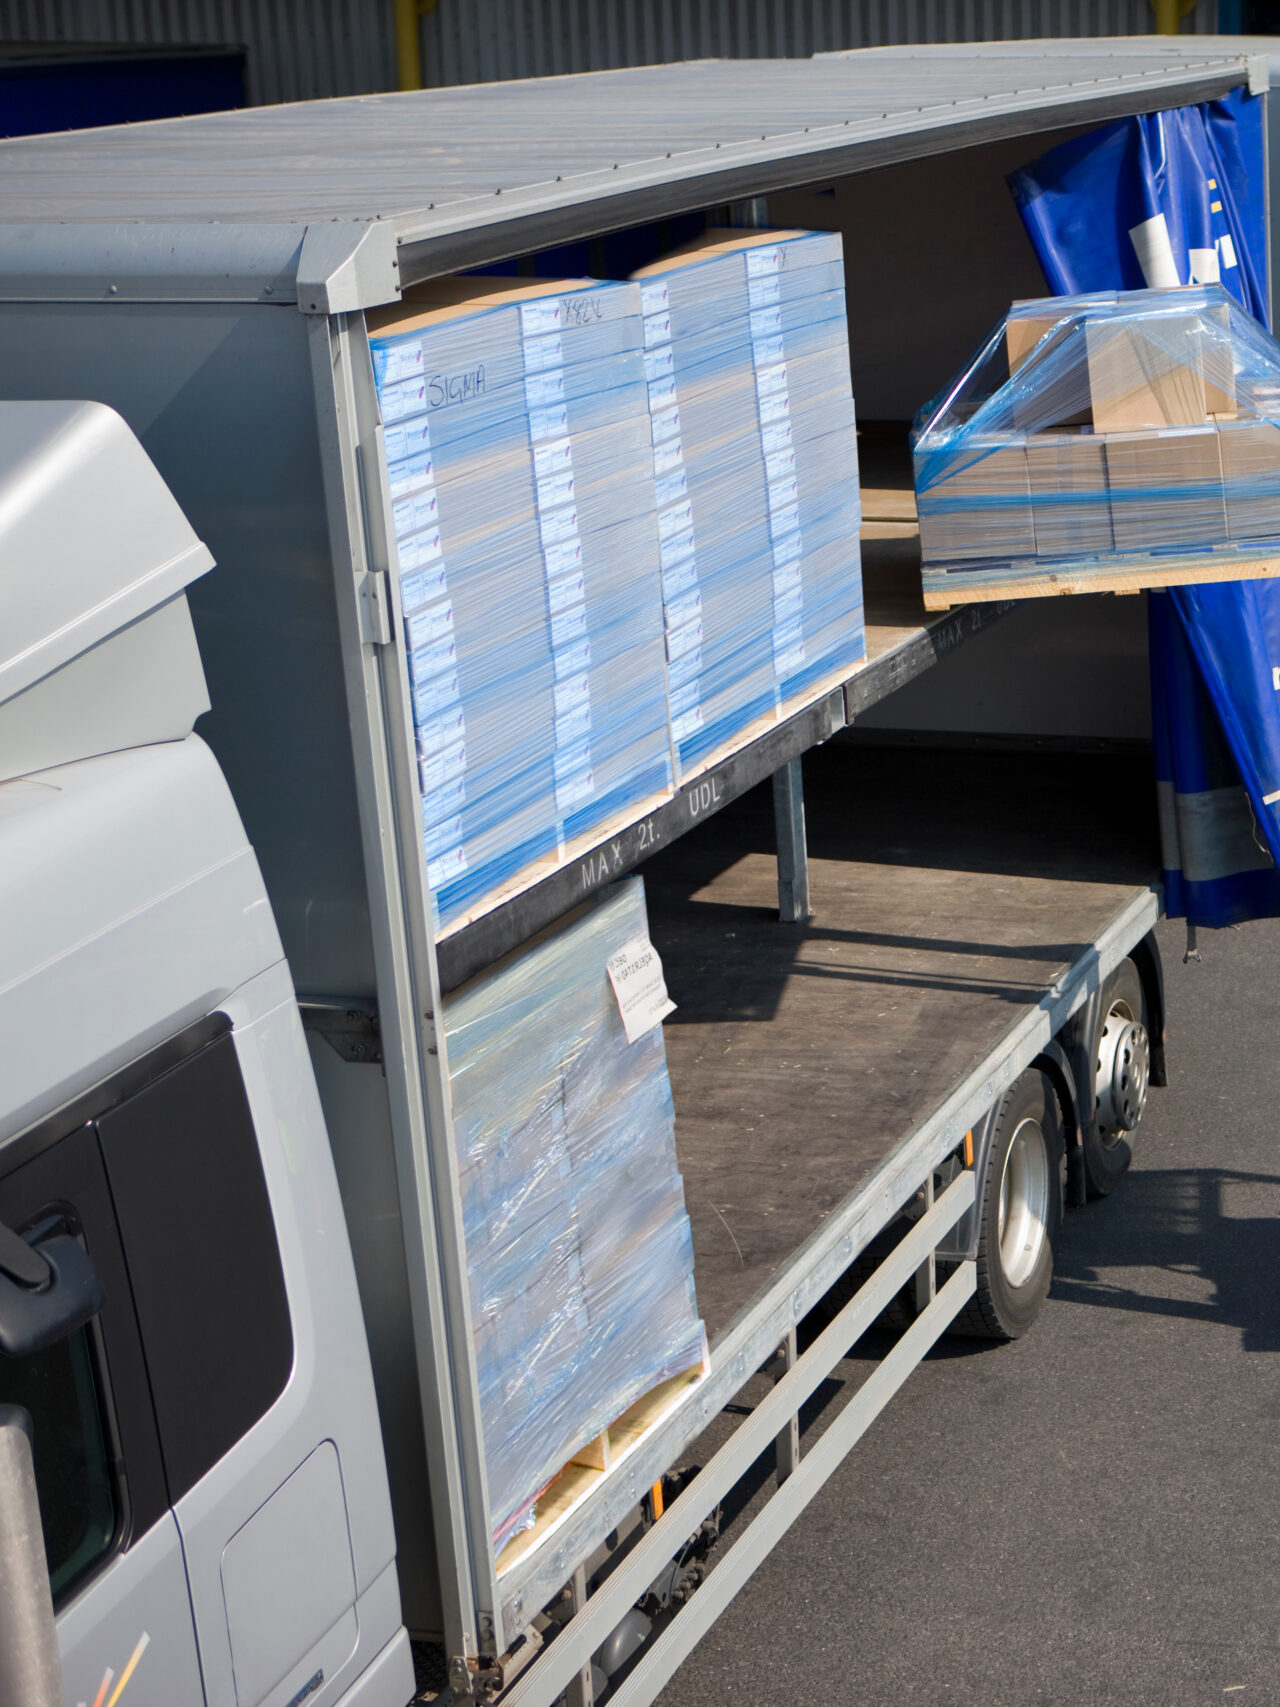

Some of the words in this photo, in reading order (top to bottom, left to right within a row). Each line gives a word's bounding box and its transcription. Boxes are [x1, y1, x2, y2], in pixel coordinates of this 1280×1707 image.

[428, 363, 486, 407] SIGMA
[582, 840, 624, 889] MAX
[689, 777, 720, 816] UDL
